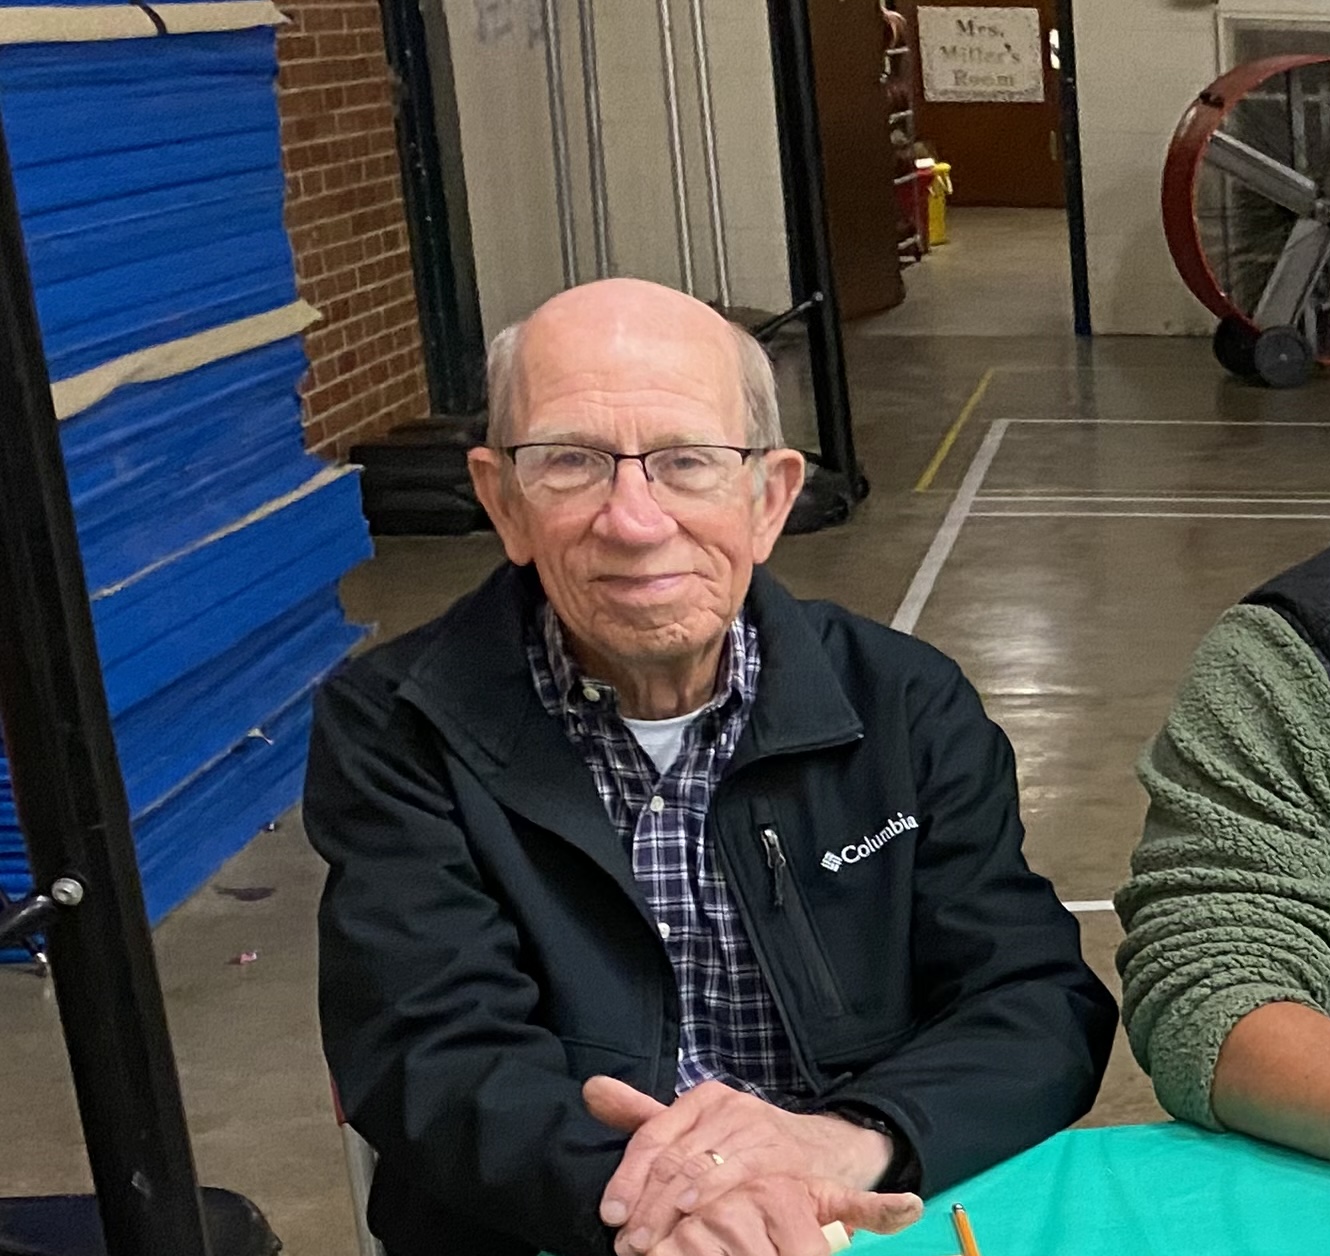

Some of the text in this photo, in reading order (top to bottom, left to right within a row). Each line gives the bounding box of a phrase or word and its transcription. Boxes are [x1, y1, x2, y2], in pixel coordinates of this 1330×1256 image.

[955, 18, 1004, 38] Mrs.
[952, 68, 1015, 87] Room
[840, 810, 919, 864] Columbia
